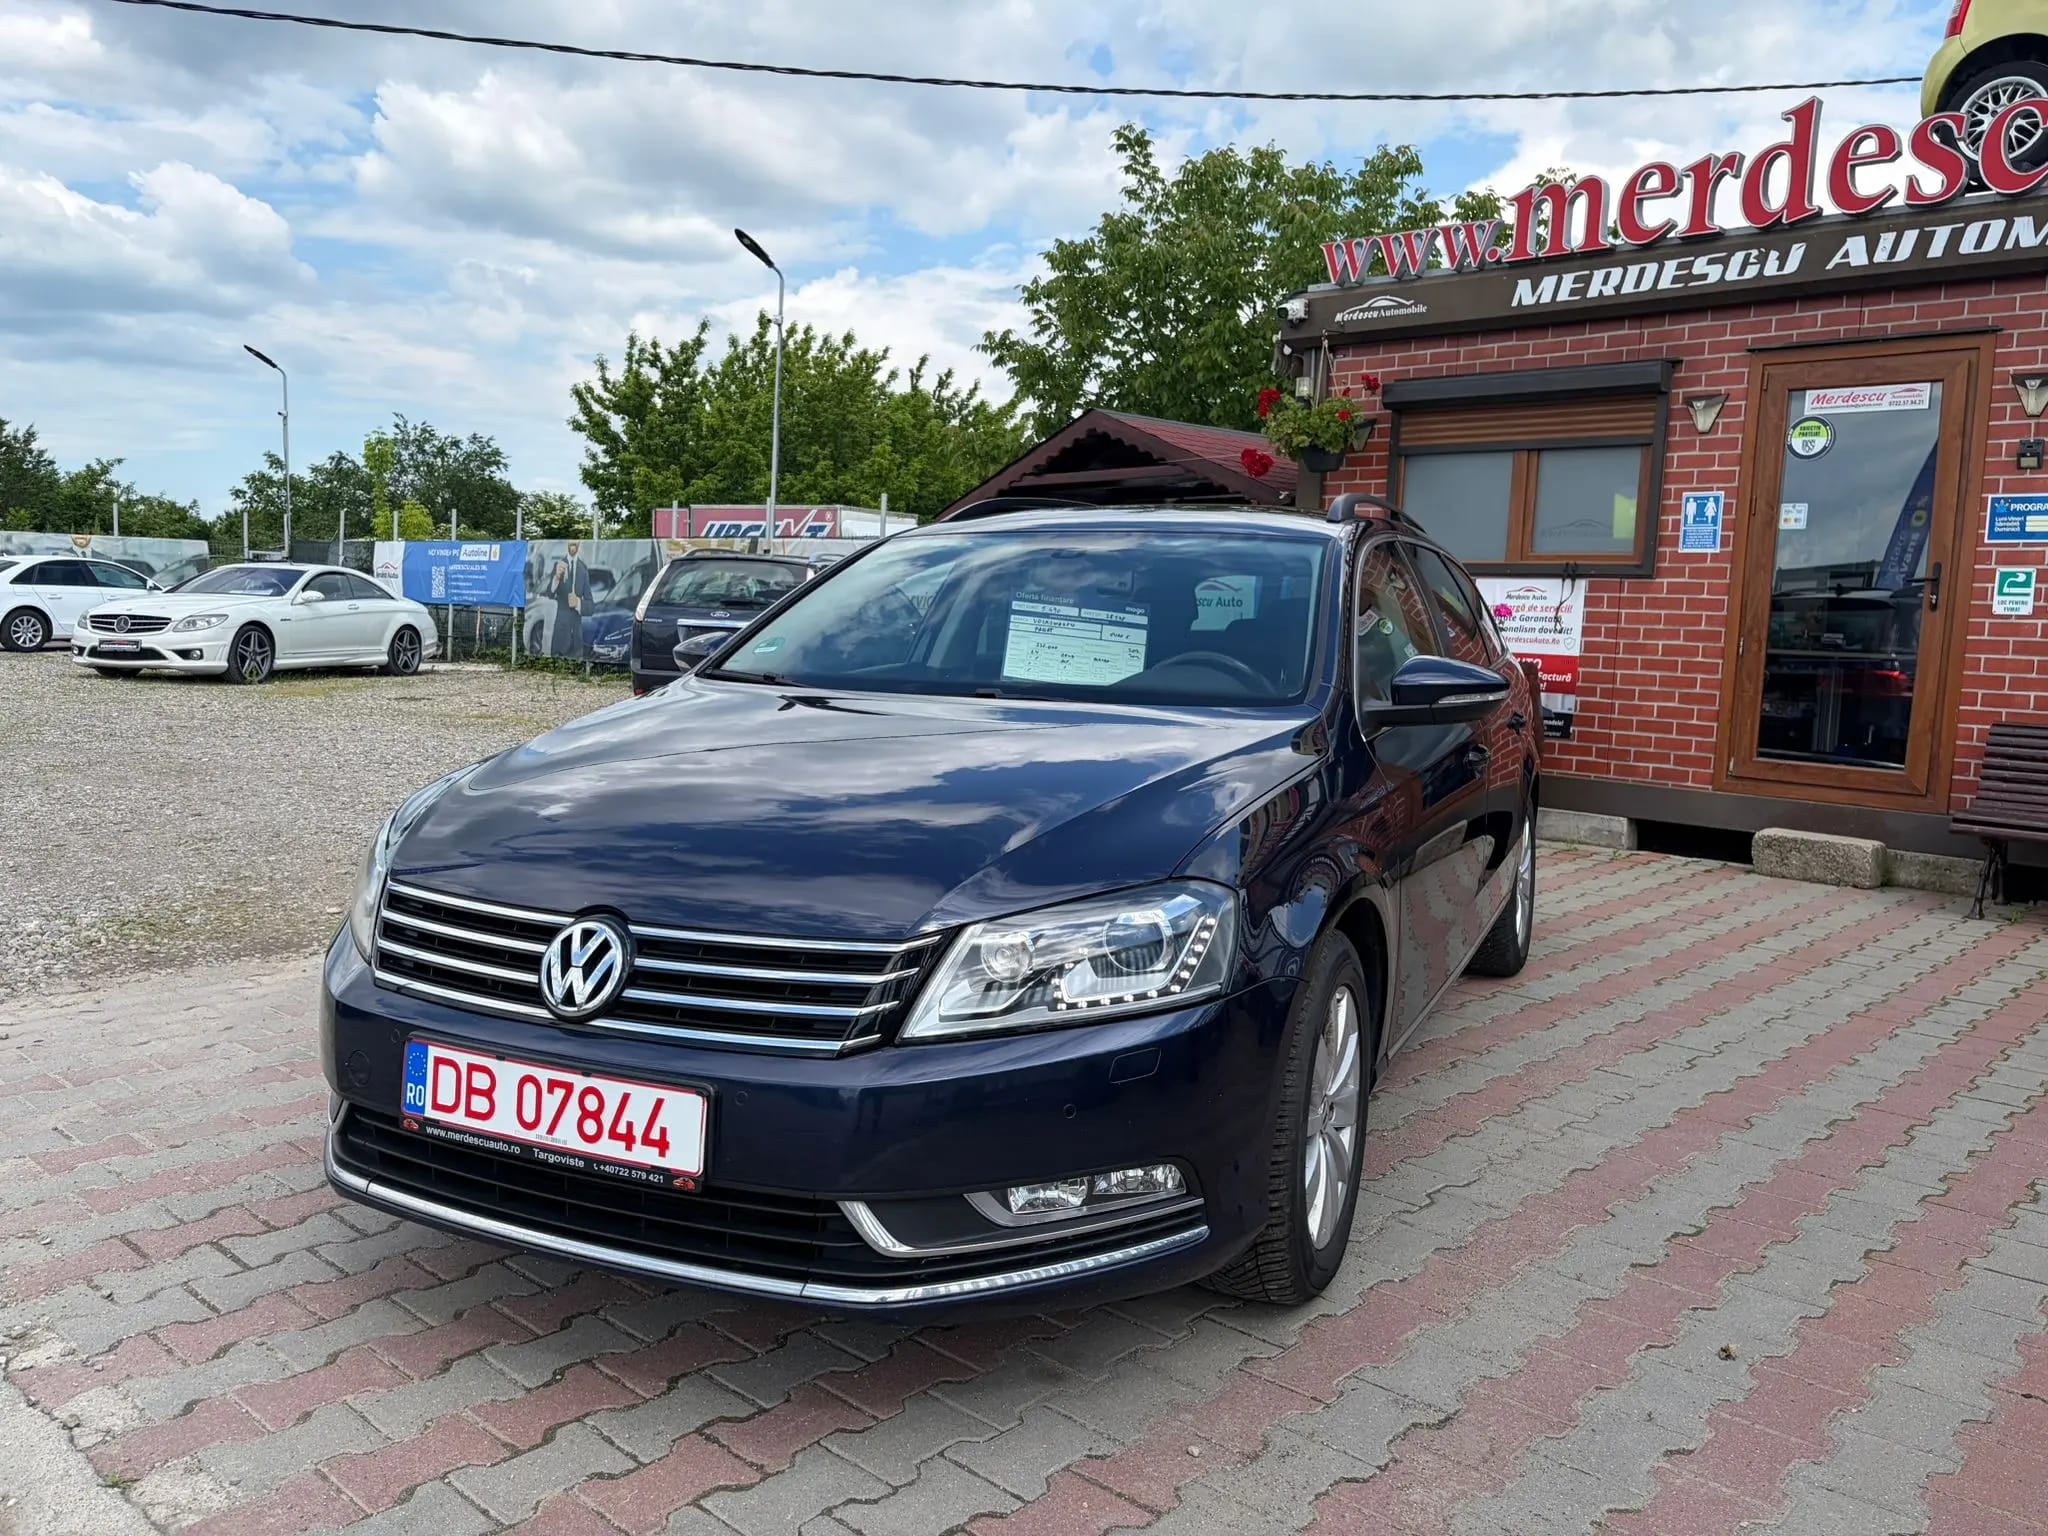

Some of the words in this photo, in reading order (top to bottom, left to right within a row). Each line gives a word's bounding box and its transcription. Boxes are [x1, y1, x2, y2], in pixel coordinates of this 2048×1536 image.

[1510, 242, 1806, 307] MERDESCU
[1334, 310, 1379, 322] Merdescu
[1379, 303, 1428, 317] Automobile
[1810, 391, 1887, 406] Merdescu
[462, 547, 488, 557] Autoline
[1215, 596, 1243, 608] Auto
[1527, 604, 1538, 612] de
[406, 1083, 425, 1107] RO
[431, 1055, 497, 1122] DB
[516, 1074, 670, 1158] 07844
[426, 1125, 521, 1154] www.merdescuauto.ro
[533, 1147, 585, 1168] Targoviste
[599, 1164, 629, 1178] +40722
[631, 1169, 647, 1182] 579
[649, 1172, 665, 1184] 421
